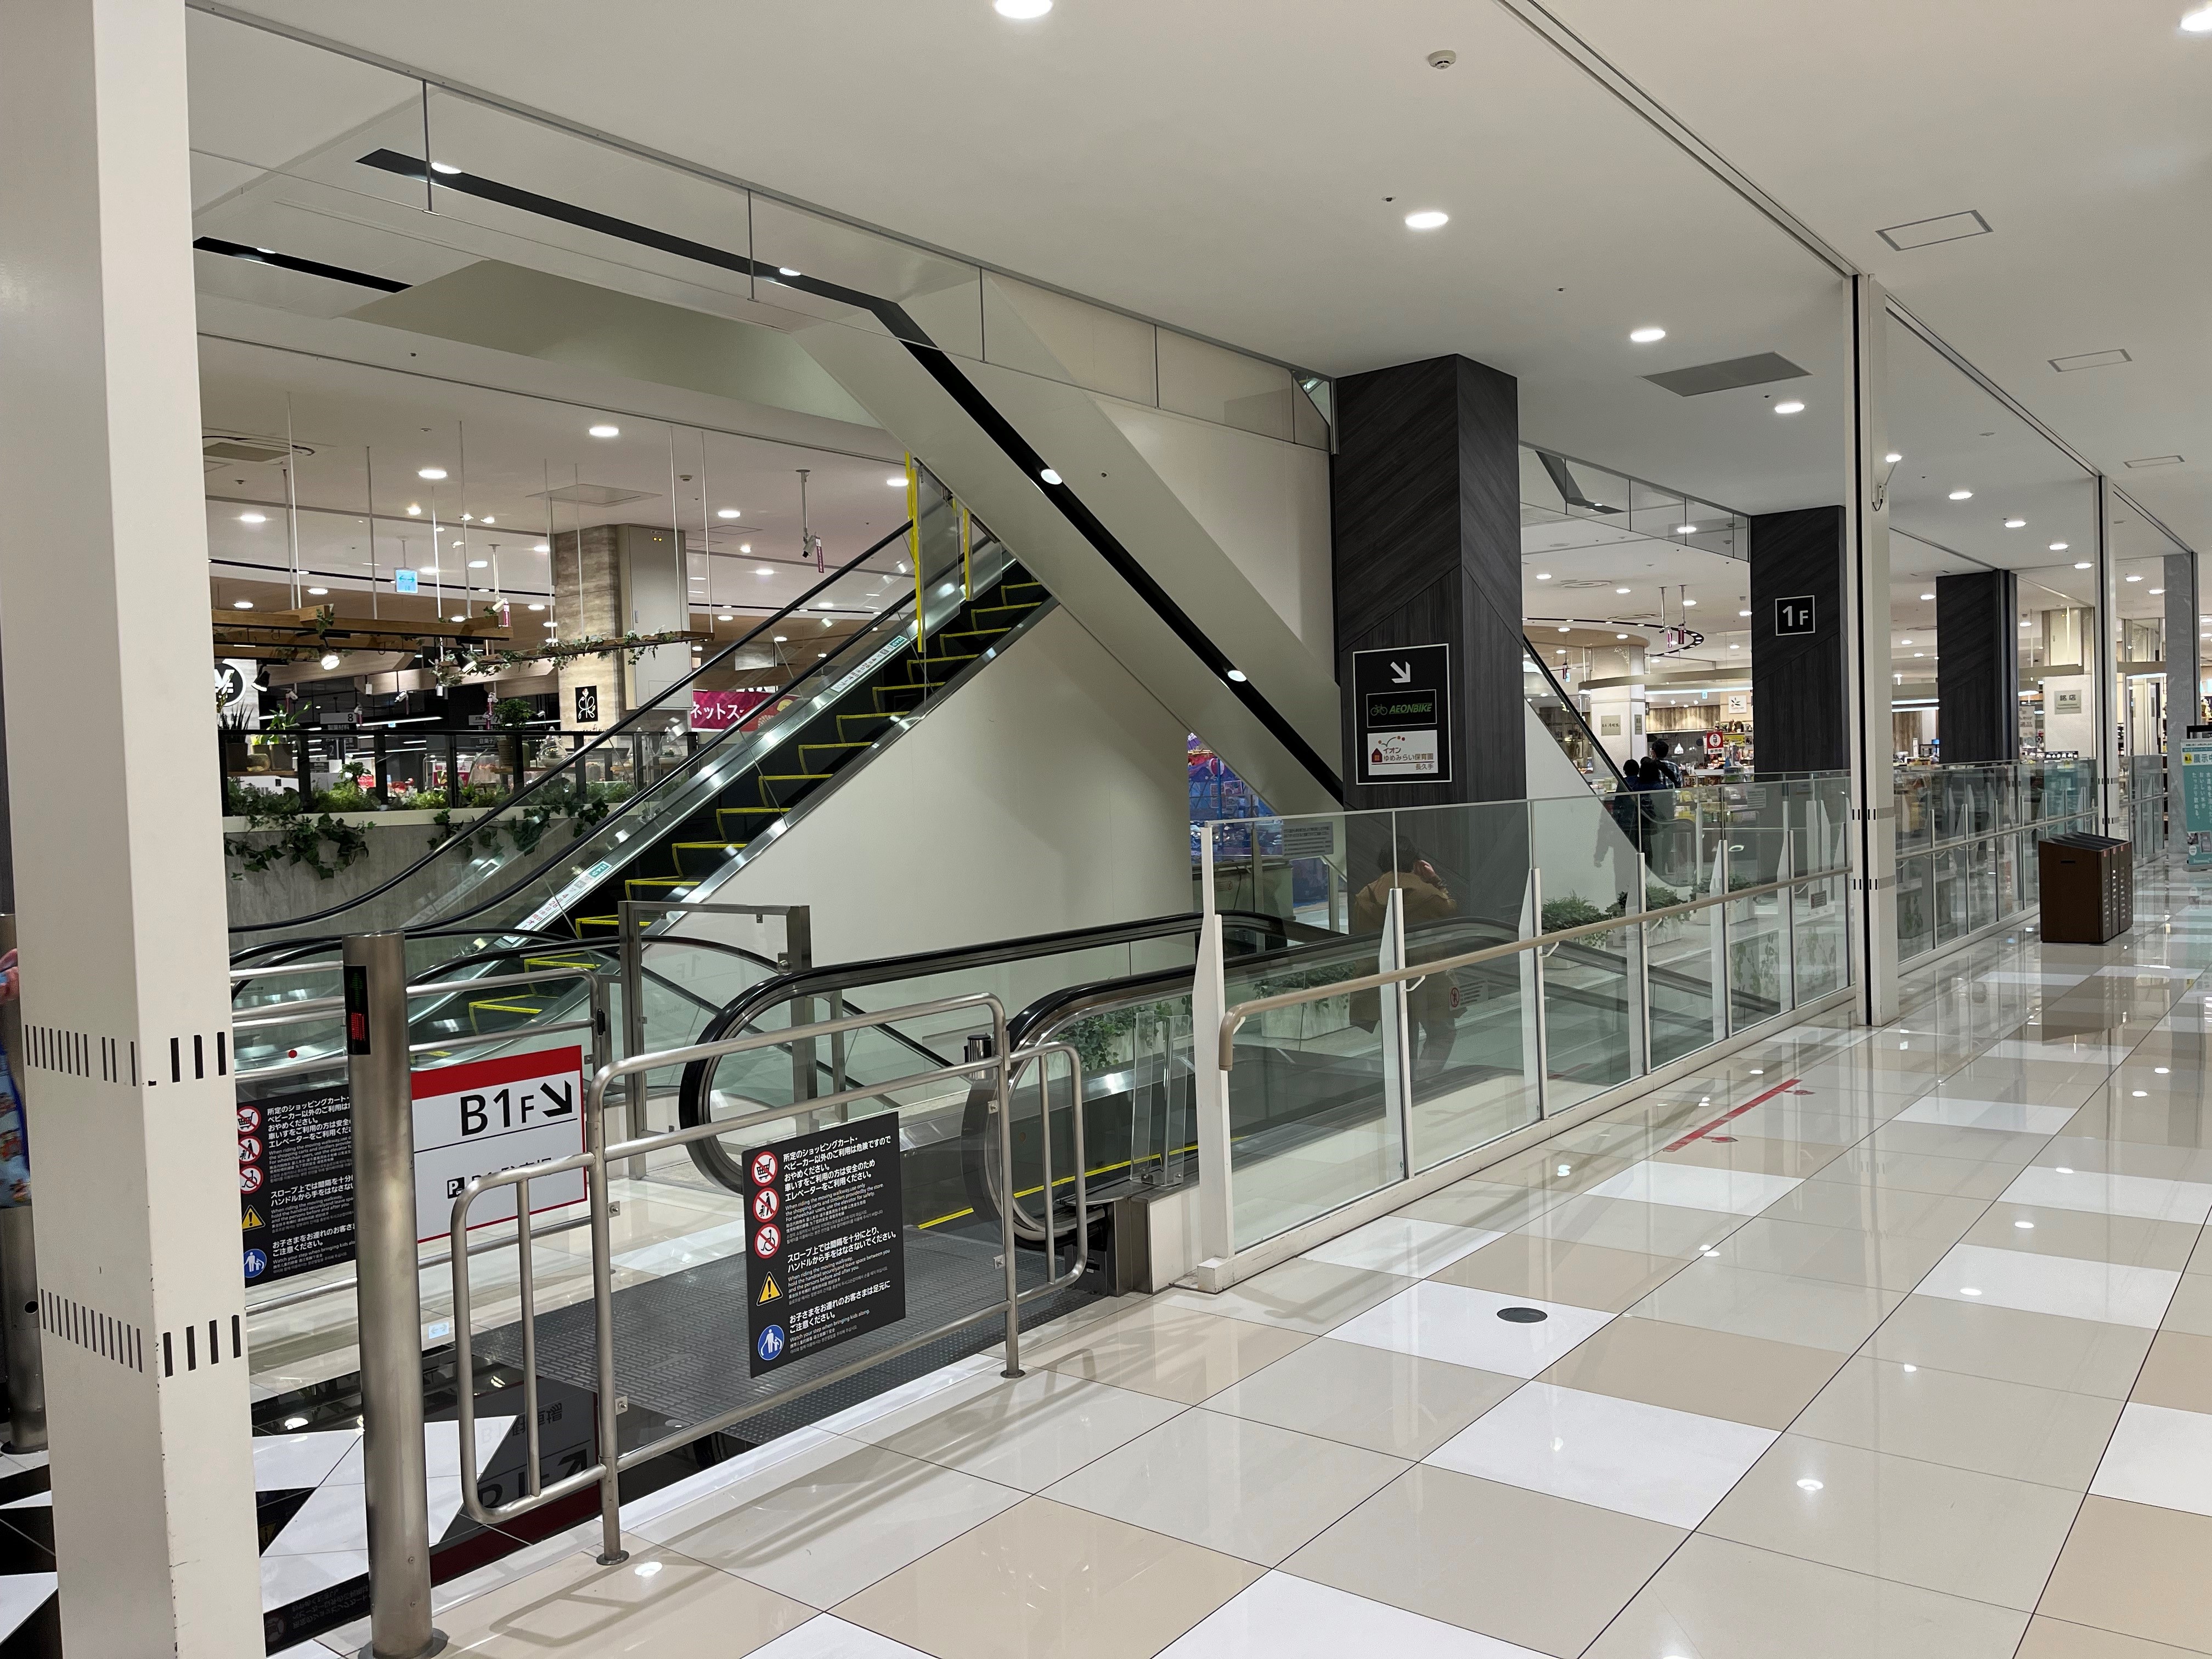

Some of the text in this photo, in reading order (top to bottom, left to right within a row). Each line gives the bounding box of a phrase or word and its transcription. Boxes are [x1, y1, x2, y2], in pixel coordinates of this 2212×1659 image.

[1782, 606, 1808, 627] 1F
[1389, 703, 1432, 714] AEONBIKE
[1384, 753, 1434, 761] ゆめみらい保育園
[460, 1088, 535, 1136] B1F
[268, 1118, 318, 1132] おやめください。
[268, 1119, 351, 1140] 車いすをご利用の方は安全
[784, 1135, 891, 1171] ベビーカー以外のご利用は危険ですので
[784, 1163, 830, 1182] おやめください。
[785, 1159, 876, 1192] 車いすをご利用の方は安全のため
[270, 1175, 353, 1199] スロープ上では間隔を十分
[785, 1171, 872, 1202] エレベーターをご利用ください。
[273, 1240, 323, 1257] ご注意ください。
[787, 1227, 879, 1263] スロープ上では間隔を十分にとり、
[787, 1232, 896, 1273] ハンドルから手をはなさないでください。
[789, 1281, 890, 1324] お子さまをお連れのお客さまは足元に
[789, 1311, 836, 1333] ご注意ください。
